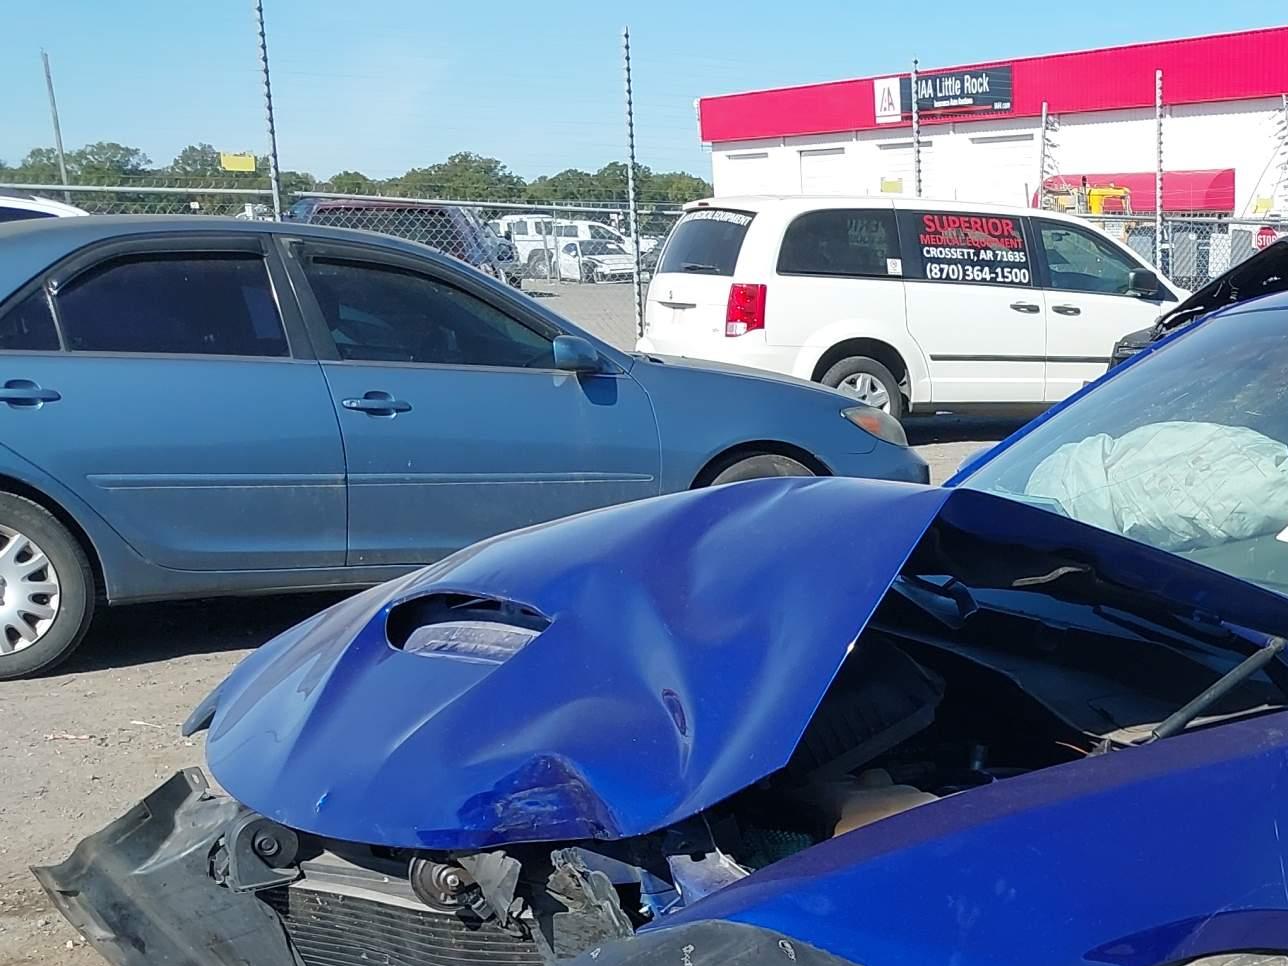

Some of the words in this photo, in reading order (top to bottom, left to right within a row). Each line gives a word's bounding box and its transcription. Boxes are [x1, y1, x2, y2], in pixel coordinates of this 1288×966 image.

[918, 79, 934, 99] IAA
[936, 77, 961, 97] Little
[964, 73, 990, 94] Rock
[713, 210, 752, 227] EQUIPMENT
[922, 215, 1014, 236] SUPERIOR
[920, 234, 961, 247] MEDICAL
[967, 235, 1024, 249] EQUIPMENT
[1258, 235, 1277, 246] STOP
[923, 246, 977, 262] CROSSETT,
[979, 249, 994, 261] AR
[996, 250, 1026, 263] 71635
[926, 262, 963, 281] (870)
[965, 265, 1029, 283] 364-1500
